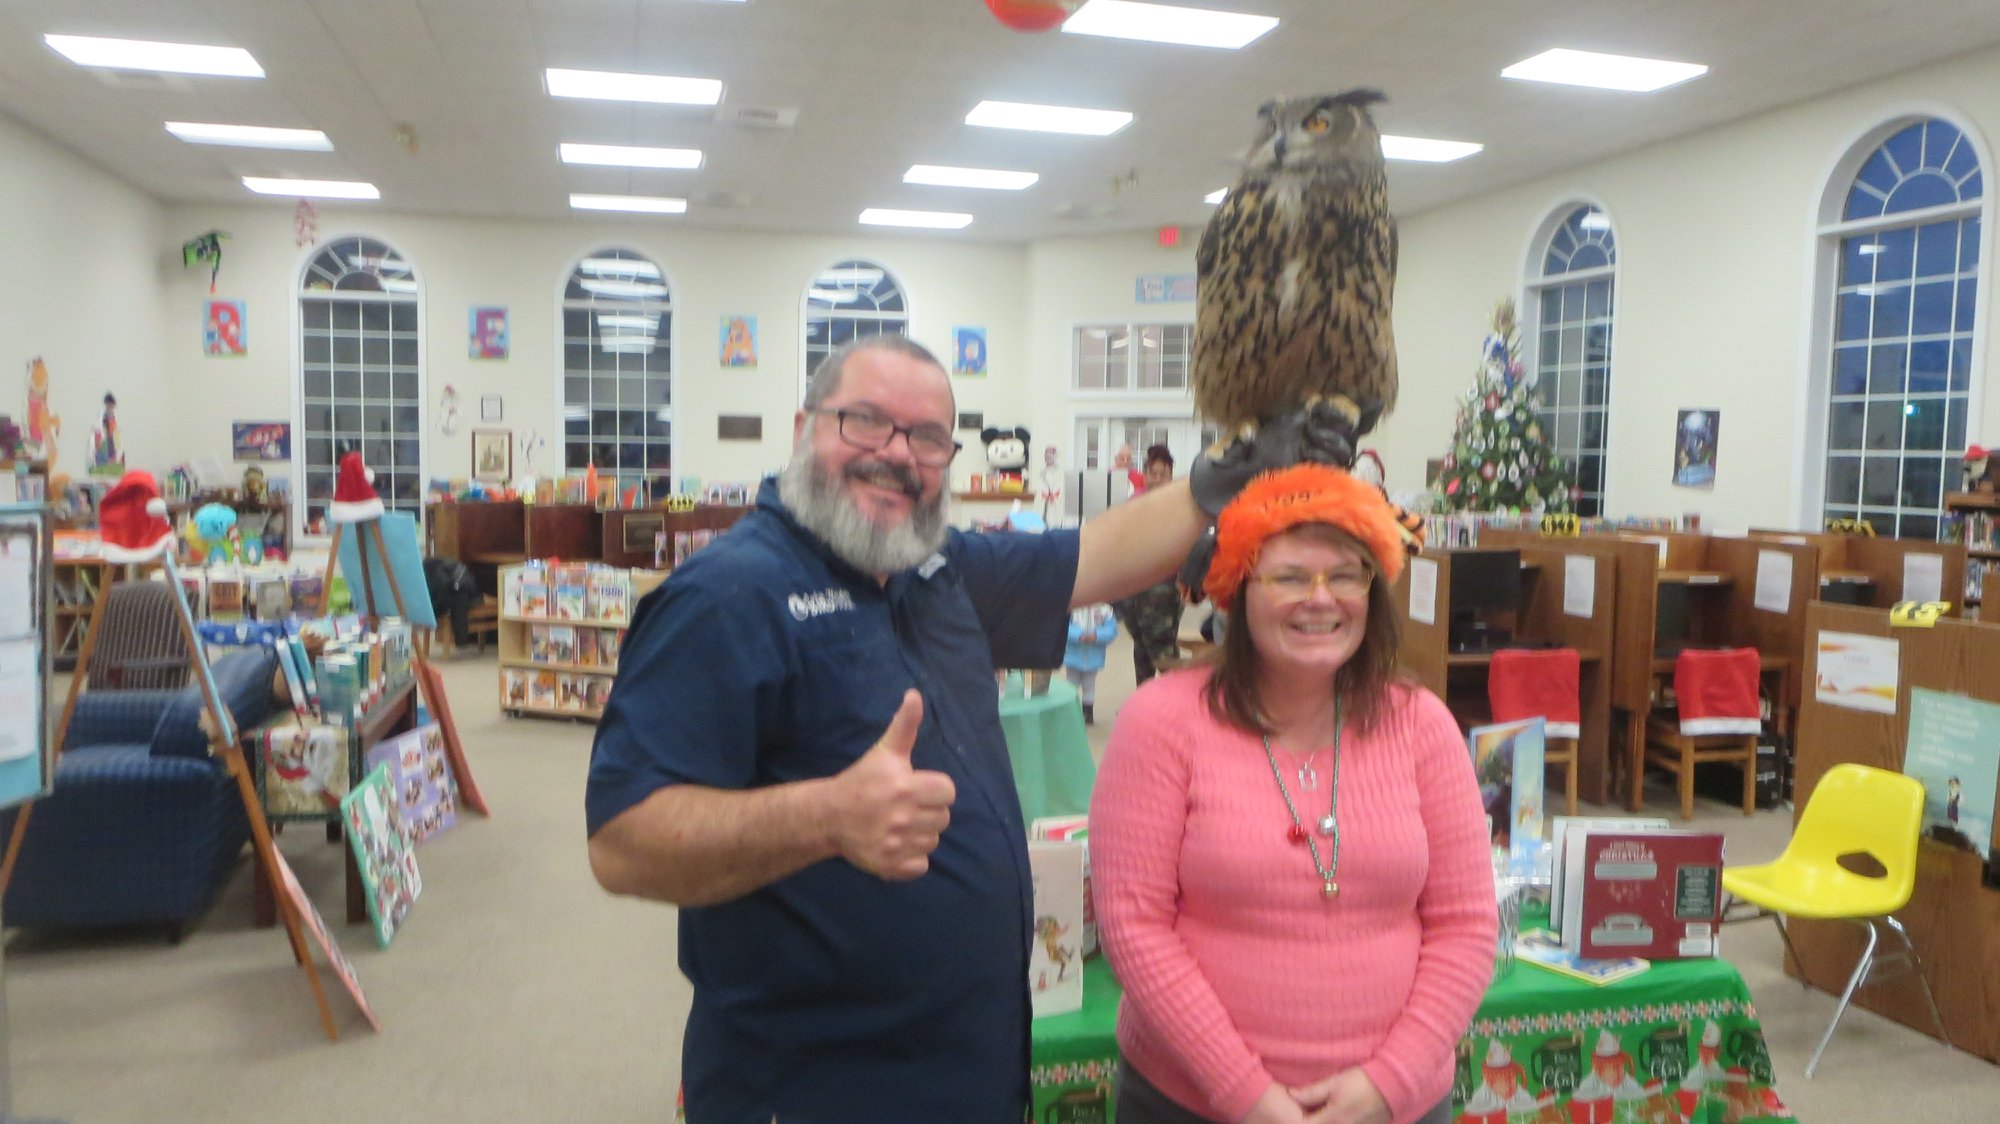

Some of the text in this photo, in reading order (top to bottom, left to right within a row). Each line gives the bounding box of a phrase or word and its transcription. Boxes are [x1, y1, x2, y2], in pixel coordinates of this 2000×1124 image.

[208, 302, 246, 355] R
[475, 307, 508, 358] E
[722, 318, 756, 367] A
[957, 328, 987, 375] D
